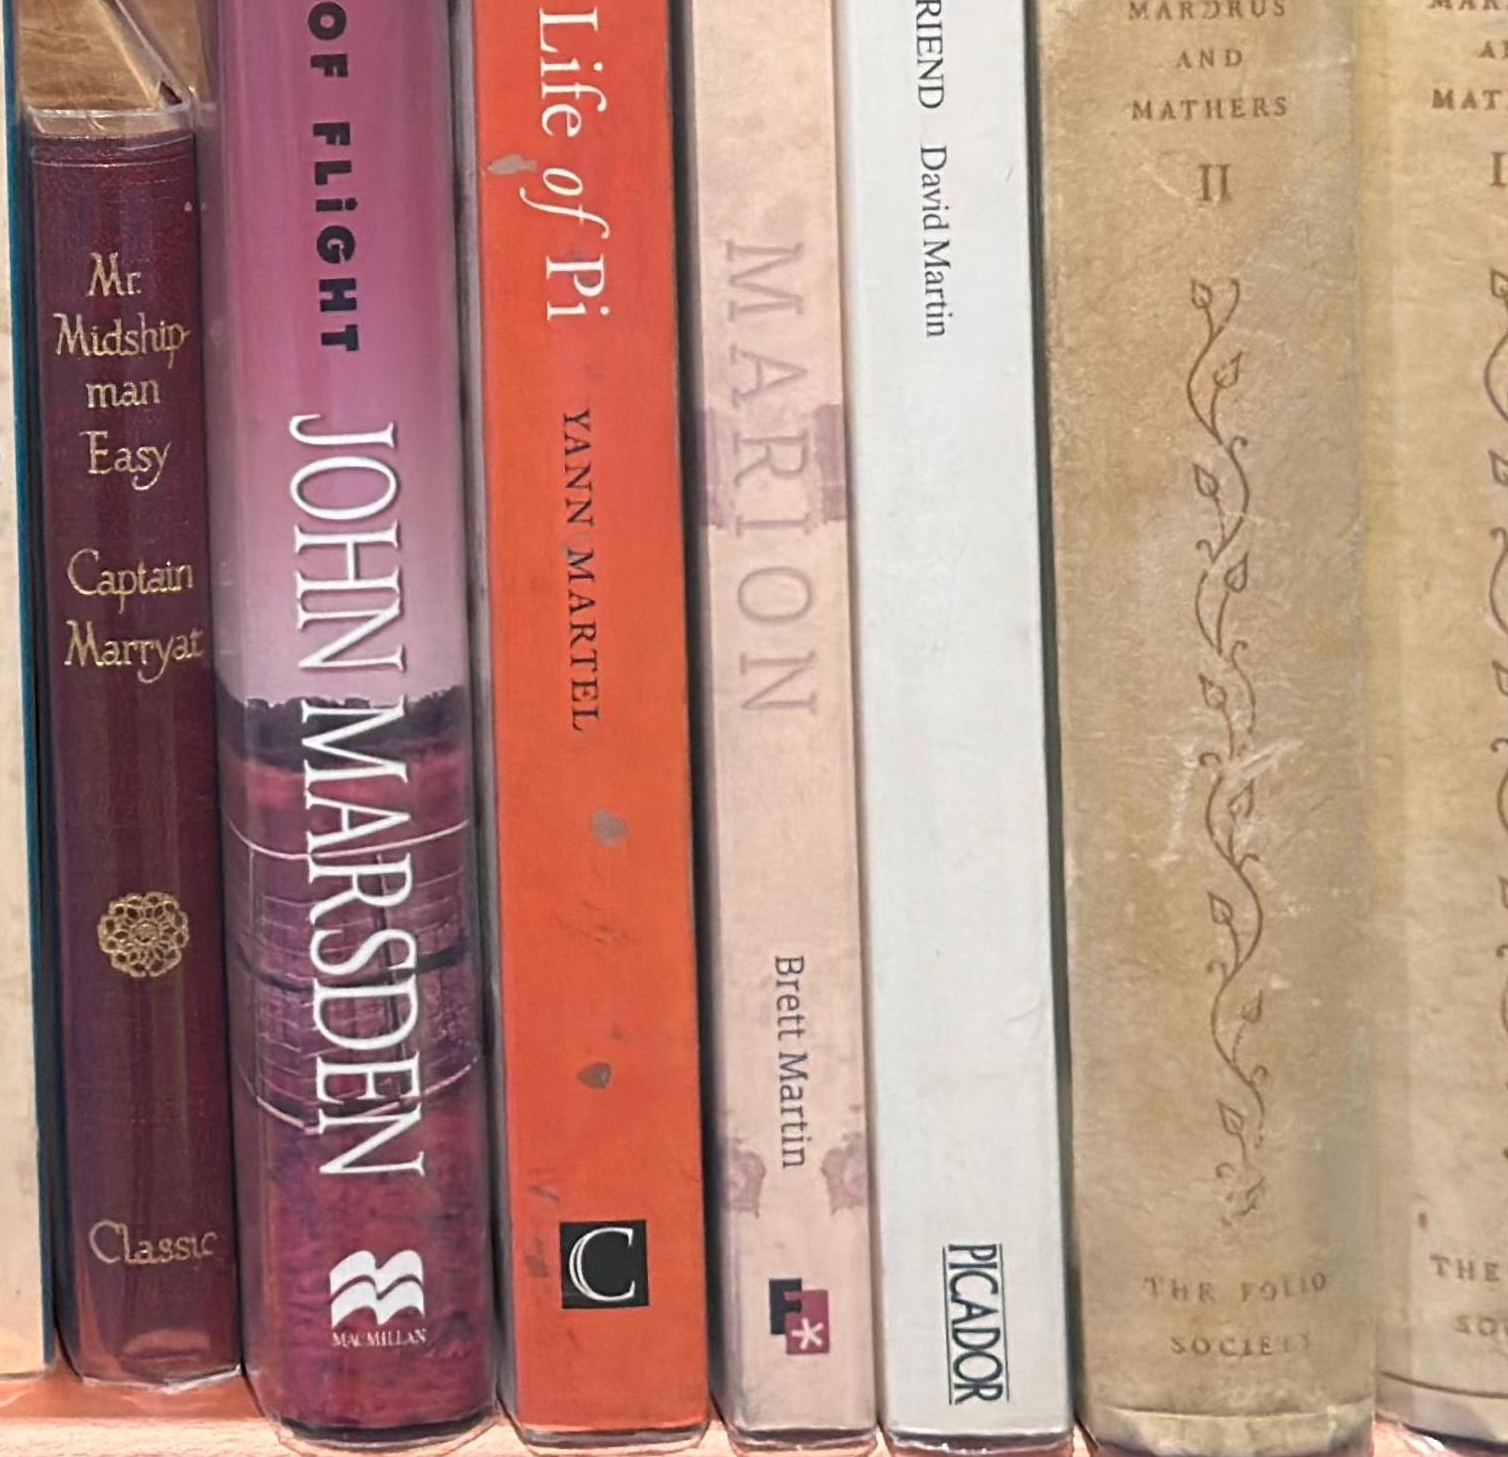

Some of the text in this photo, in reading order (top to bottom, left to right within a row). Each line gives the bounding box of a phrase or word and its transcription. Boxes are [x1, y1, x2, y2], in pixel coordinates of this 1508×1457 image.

[307, 1, 349, 78] OF
[1177, 49, 1244, 69] AND
[1132, 97, 1287, 121] MATHERS
[520, 7, 610, 321] Life of Pi
[920, 145, 948, 230] David
[1197, 164, 1233, 203] II
[86, 251, 142, 297] Mr.
[923, 239, 950, 338] Martin
[86, 380, 161, 409] man
[79, 430, 172, 491] Easy
[725, 239, 818, 716] MARION
[67, 548, 193, 615] Captain
[562, 408, 600, 732] YANN MARTEL
[65, 620, 203, 683] Marryat
[288, 414, 425, 1175] JOHN MARSDEN
[775, 955, 812, 1168] Brett Martin
[89, 1220, 217, 1265] Classic
[1430, 1254, 1500, 1283] THE
[332, 1328, 426, 1349] MACMILLAN
[948, 1244, 1004, 1405] PICADOR
